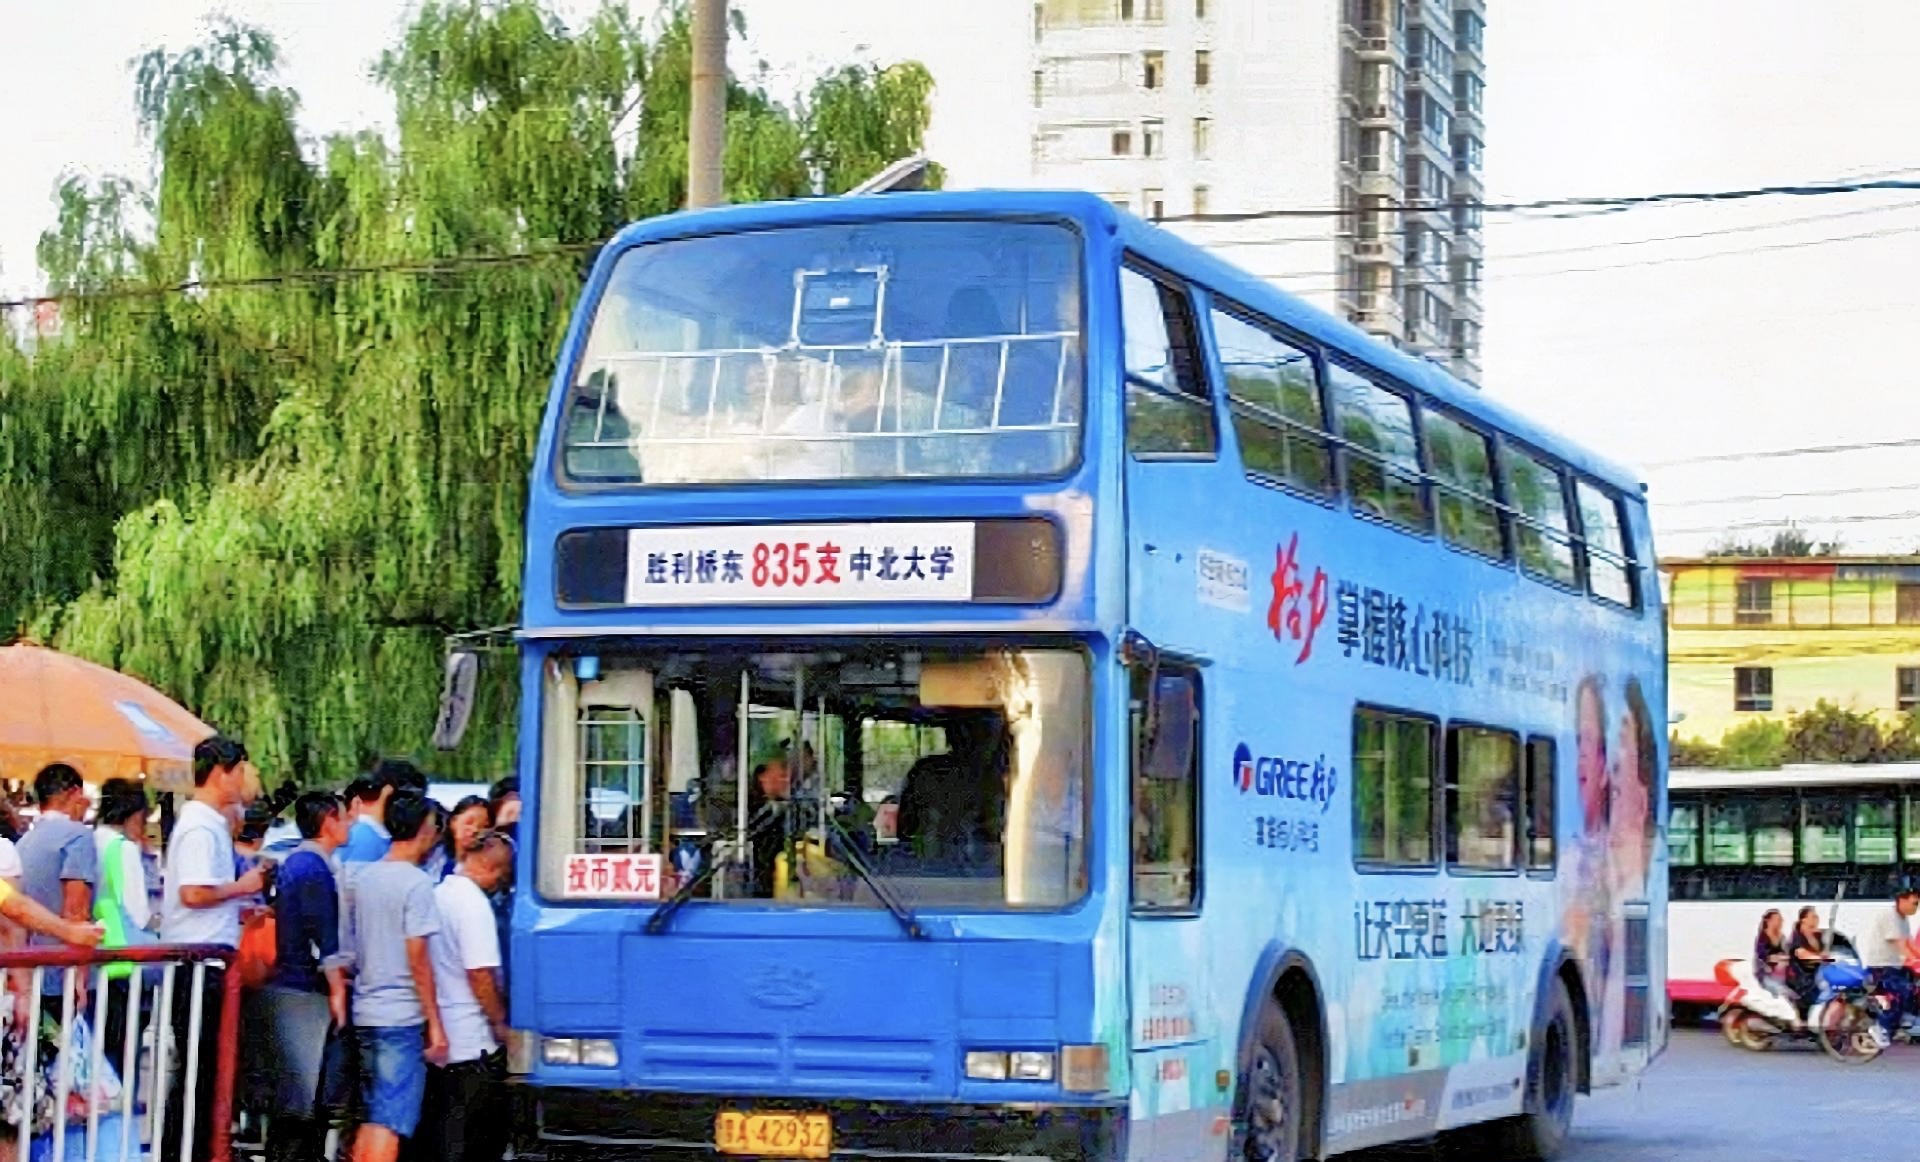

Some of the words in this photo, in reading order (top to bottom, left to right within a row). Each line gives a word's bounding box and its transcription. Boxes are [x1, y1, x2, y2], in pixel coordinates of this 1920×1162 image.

[645, 549, 744, 584] 胜利桥东
[752, 541, 841, 588] 835支
[850, 545, 954, 580] 中北大学
[1255, 756, 1309, 801] GREE
[568, 858, 655, 892] 投币贰元
